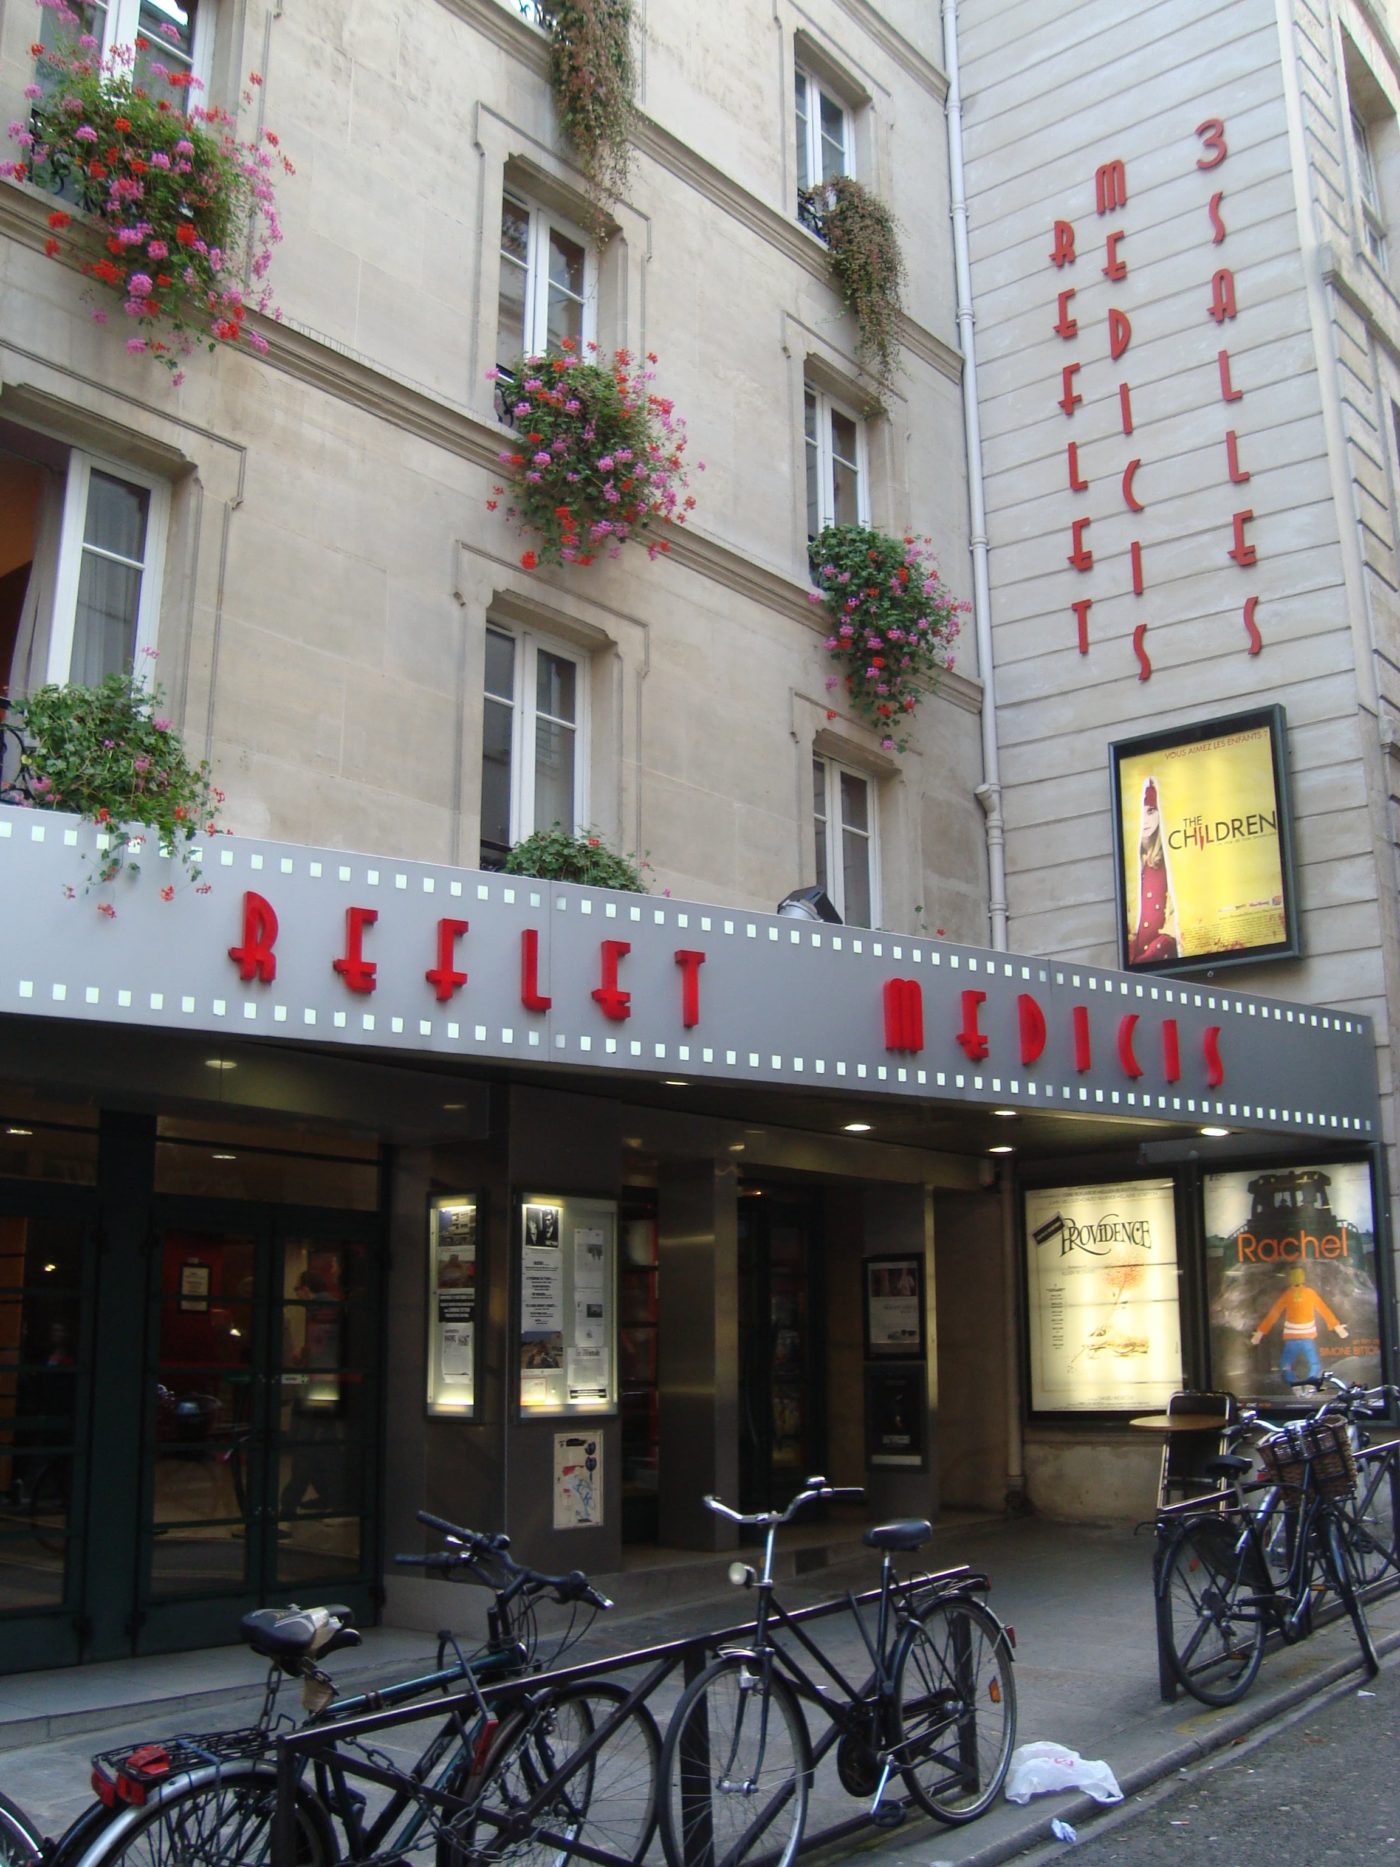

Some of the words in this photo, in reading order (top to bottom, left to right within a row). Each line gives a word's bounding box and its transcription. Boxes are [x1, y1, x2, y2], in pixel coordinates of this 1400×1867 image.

[1195, 118, 1228, 170] 3
[1049, 220, 1093, 655] REFLET
[1095, 159, 1151, 682] MEDICIS
[1207, 191, 1263, 656] SALLES
[1164, 748, 1189, 760] VOUS
[1213, 738, 1226, 750] LES
[1168, 810, 1277, 851] CHILDREN
[1183, 815, 1203, 828] THE
[228, 891, 706, 1028] REFLET
[883, 977, 1225, 1090] MEDICIS
[1237, 1227, 1348, 1264] Rachel
